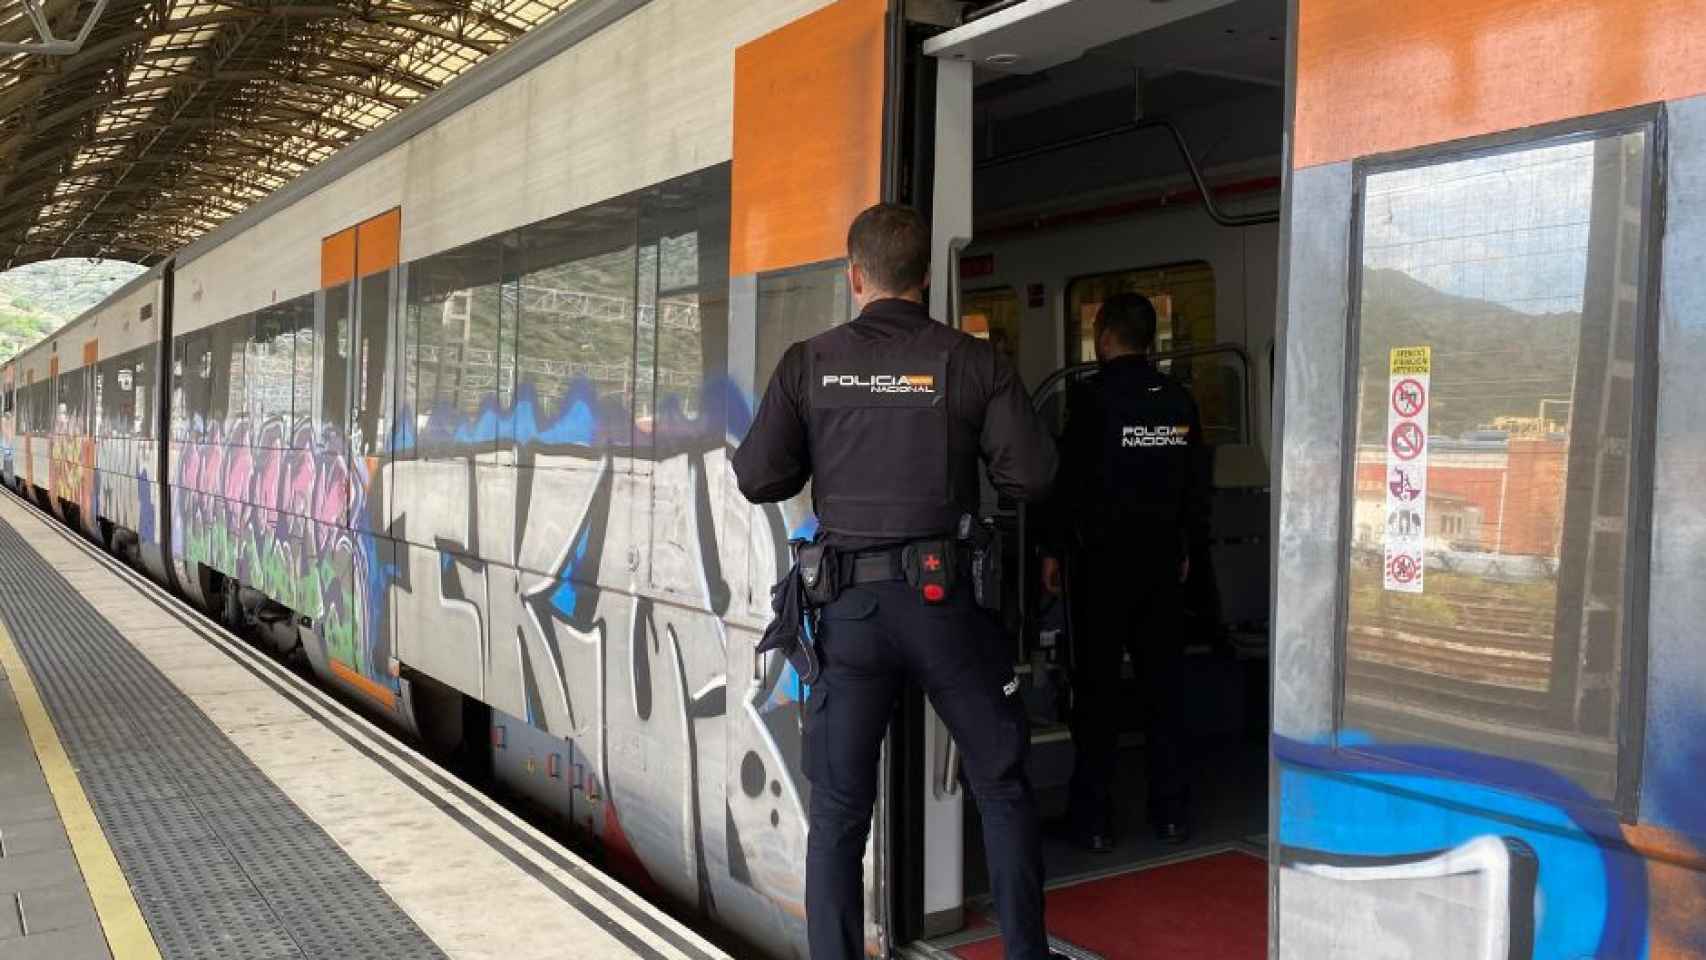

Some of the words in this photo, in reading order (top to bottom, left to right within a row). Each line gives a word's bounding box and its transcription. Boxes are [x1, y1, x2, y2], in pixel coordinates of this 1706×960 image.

[823, 375, 911, 386] POLICIA
[1122, 426, 1176, 436] POLICIA
[1122, 436, 1188, 447] NACIONAL
